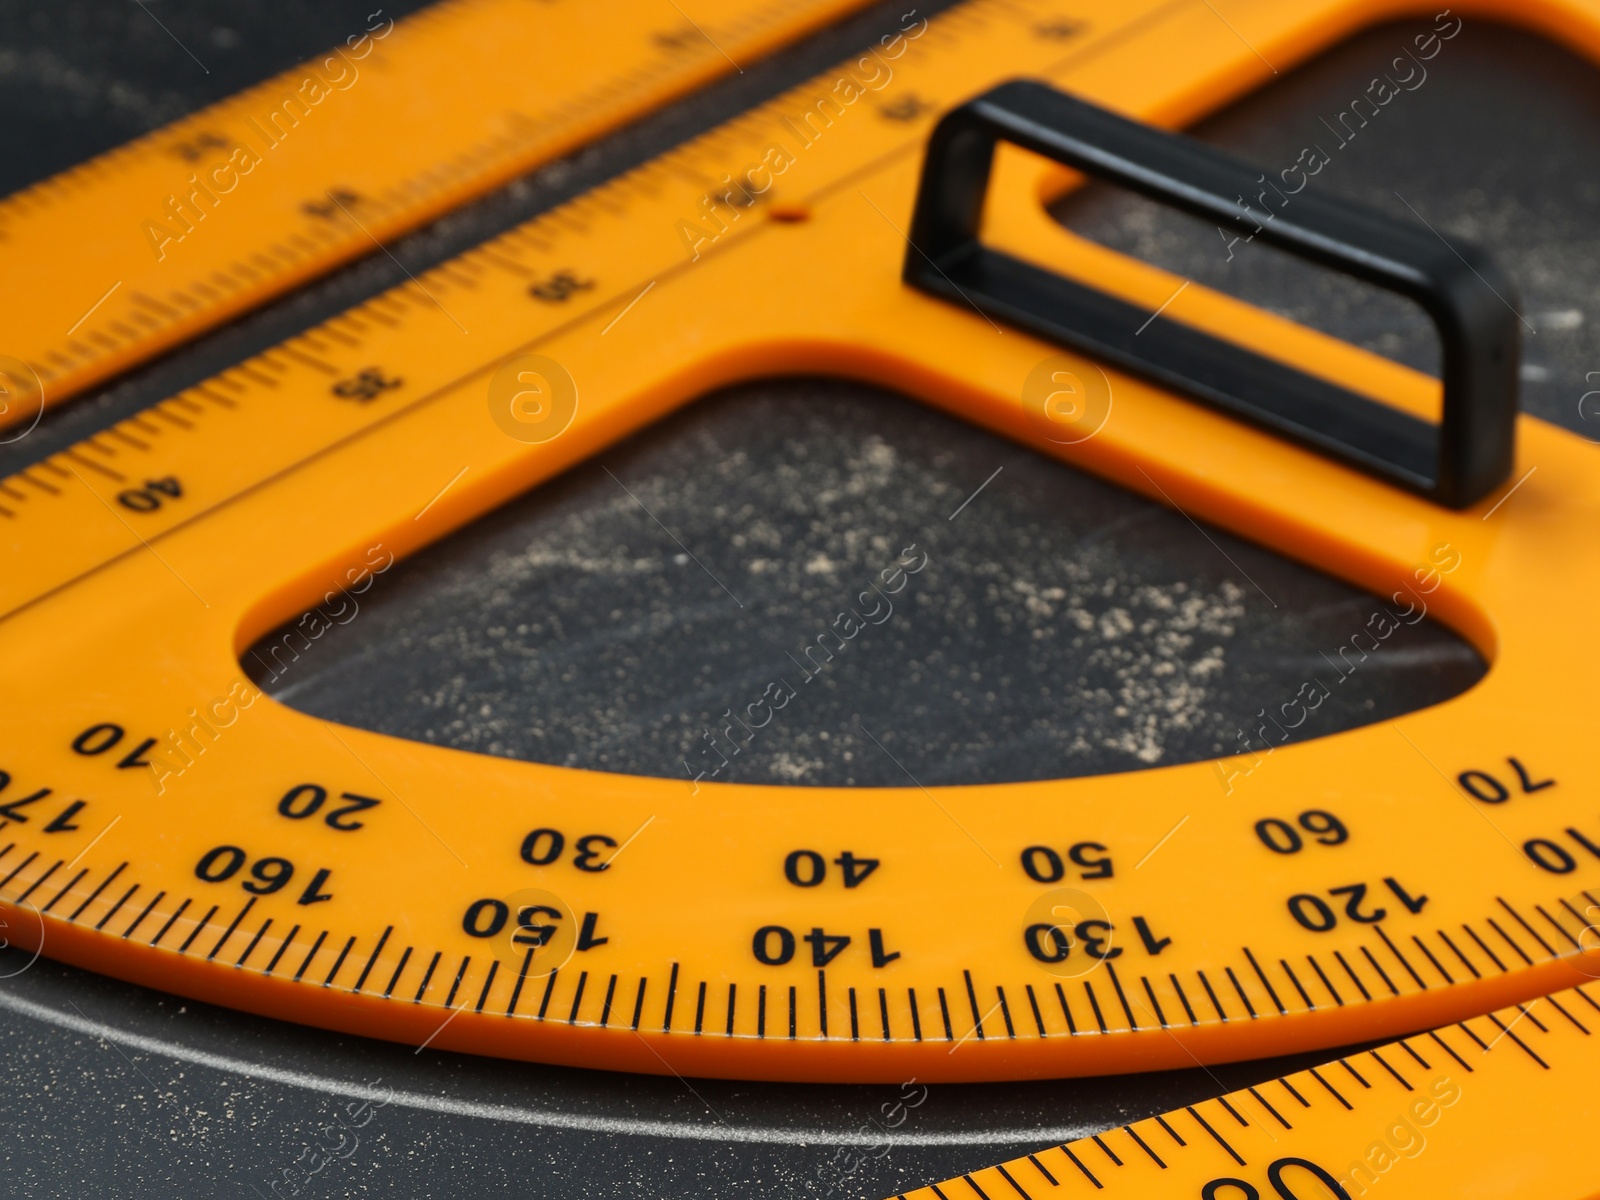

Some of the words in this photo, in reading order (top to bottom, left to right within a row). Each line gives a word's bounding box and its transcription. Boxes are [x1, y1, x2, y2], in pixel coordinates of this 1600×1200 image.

[116, 476, 184, 514] 40
[71, 722, 158, 770] 10
[0, 768, 87, 834] 17
[1457, 756, 1556, 805] 70
[277, 783, 382, 832] 20
[520, 828, 618, 873] 30
[1254, 809, 1350, 855] 60
[1522, 827, 1600, 875] 10
[194, 845, 334, 907] 160
[784, 849, 880, 889] 40
[1020, 842, 1114, 884] 50
[461, 898, 609, 952] 150
[1287, 876, 1429, 934] 120
[751, 925, 901, 969] 140
[1023, 916, 1172, 965] 130
